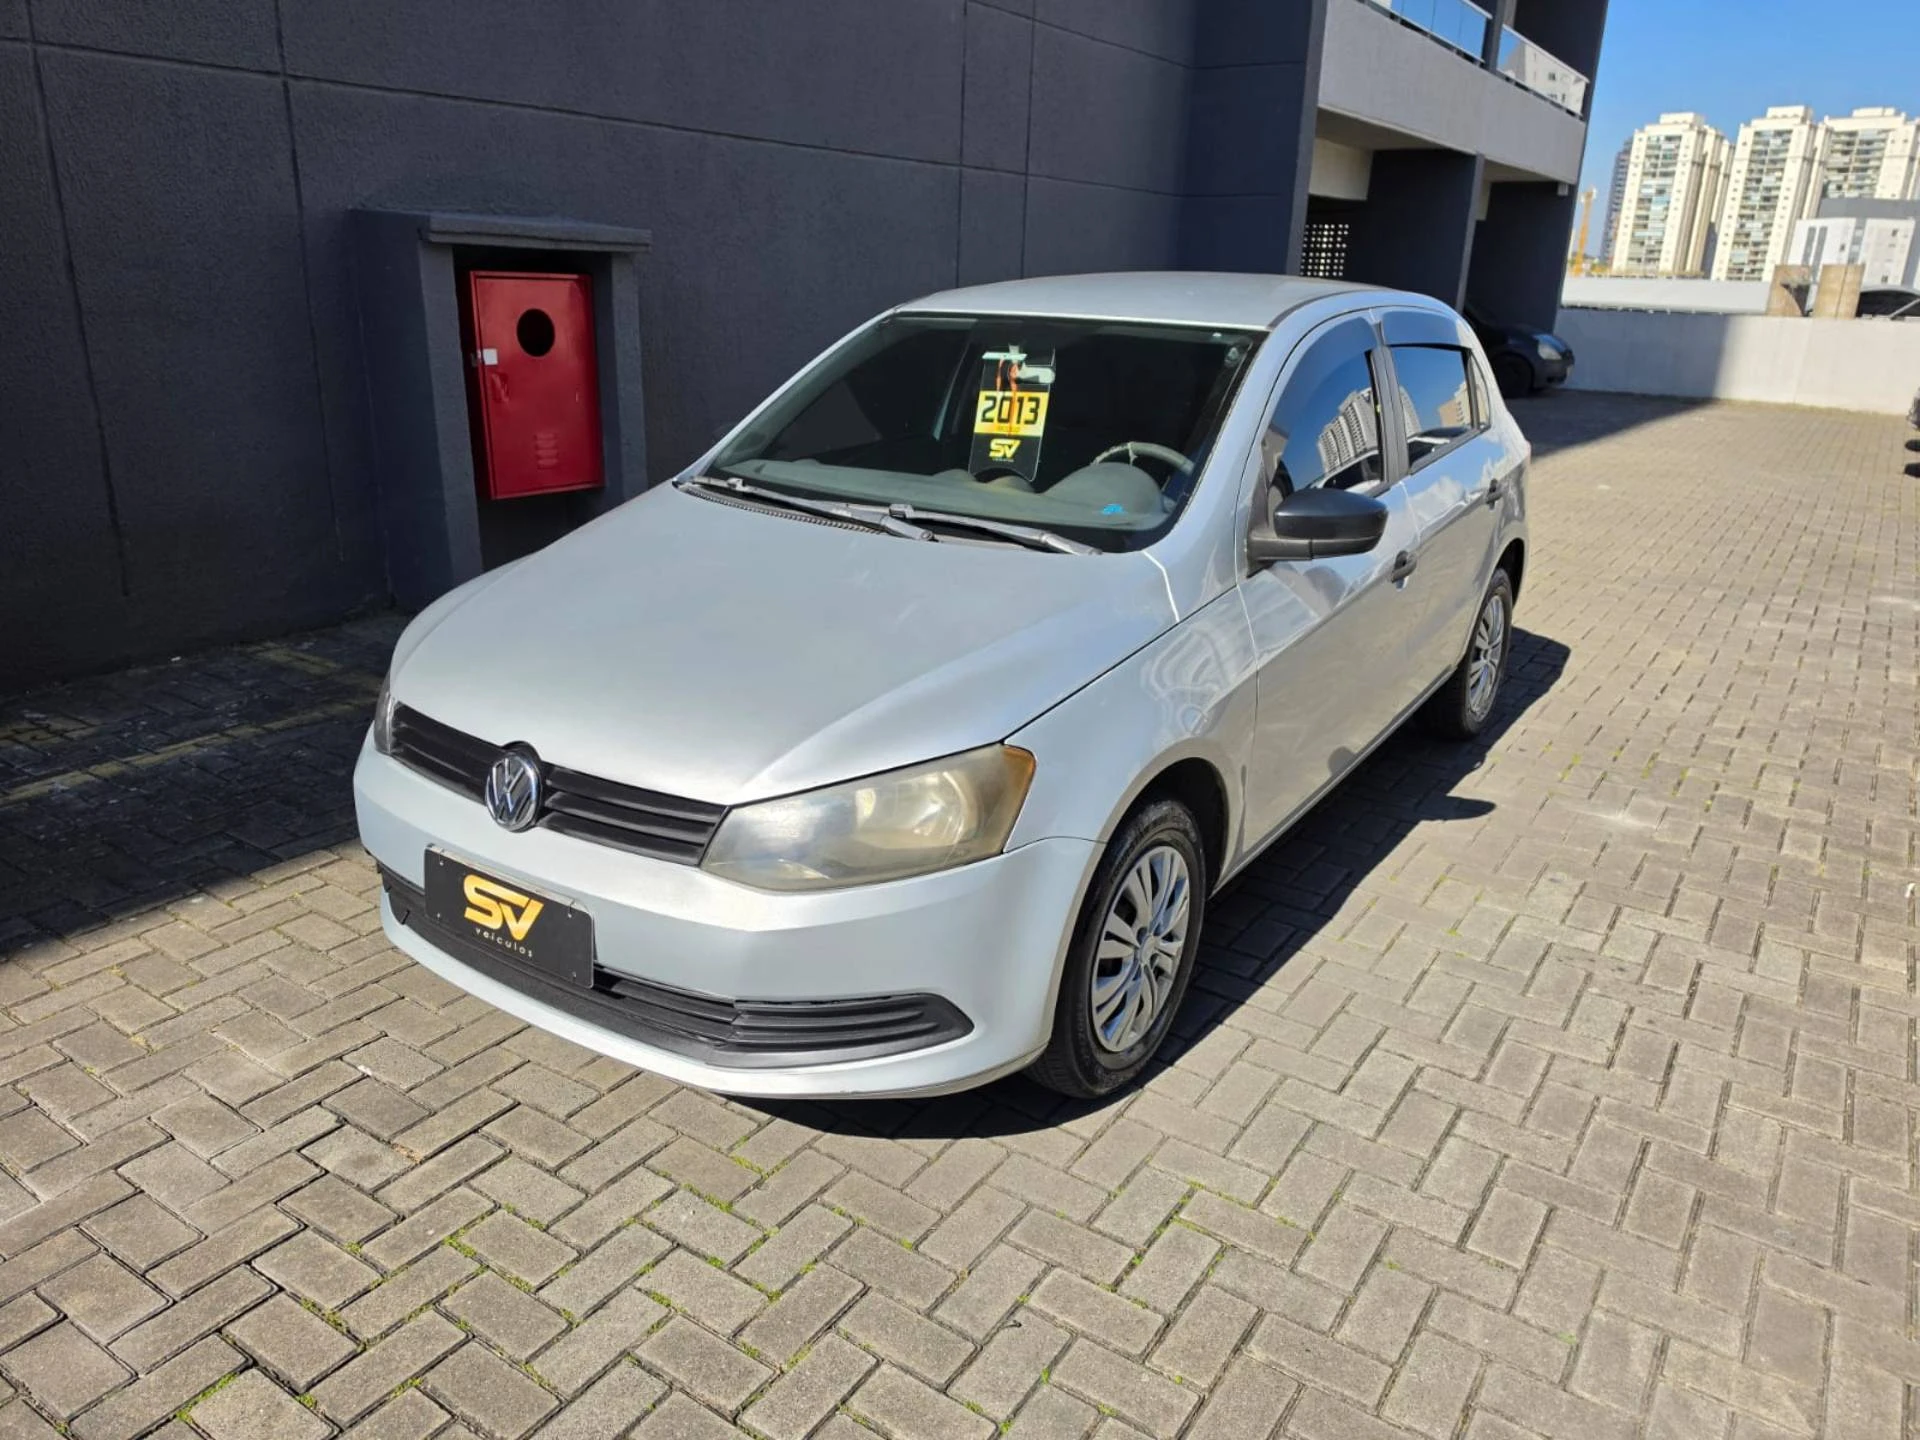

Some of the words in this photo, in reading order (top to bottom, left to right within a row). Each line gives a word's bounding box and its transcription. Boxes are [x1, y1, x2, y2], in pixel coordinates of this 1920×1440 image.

[981, 396, 1041, 425] 2013
[989, 438, 1021, 459] SV
[463, 874, 544, 941] SV
